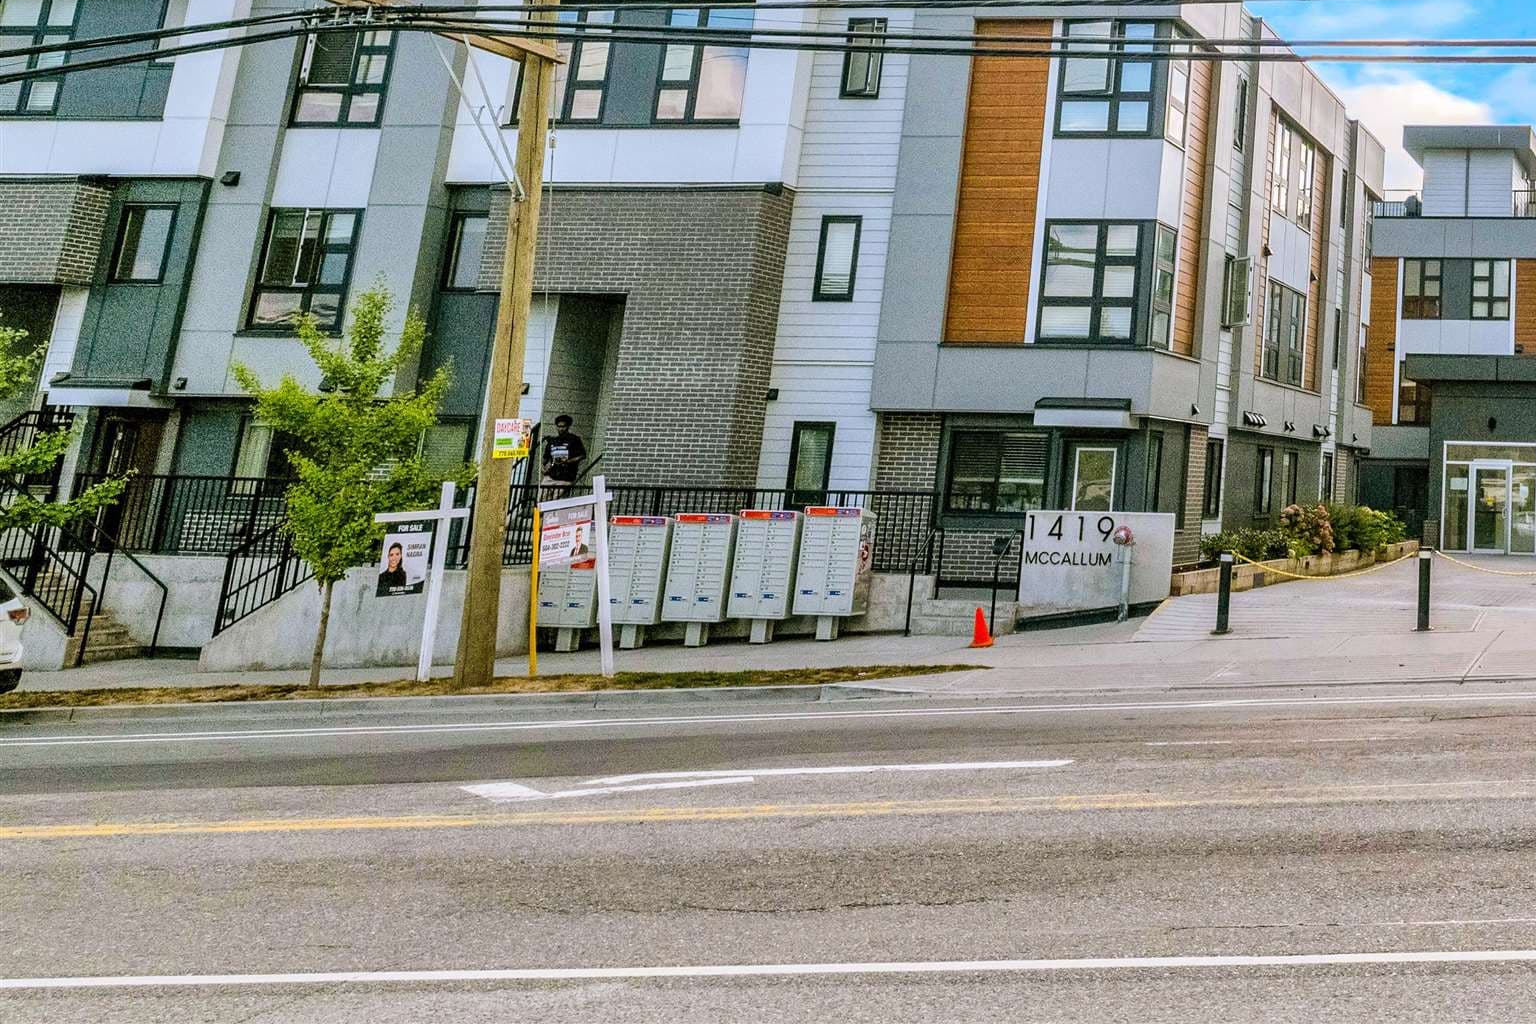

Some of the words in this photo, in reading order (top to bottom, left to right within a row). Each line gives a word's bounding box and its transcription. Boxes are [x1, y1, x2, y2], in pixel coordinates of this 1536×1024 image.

[496, 422, 521, 433] DAYCARE
[410, 524, 424, 532] SALE
[1029, 515, 1115, 542] 1419
[1024, 551, 1112, 567] MCCALLUM
